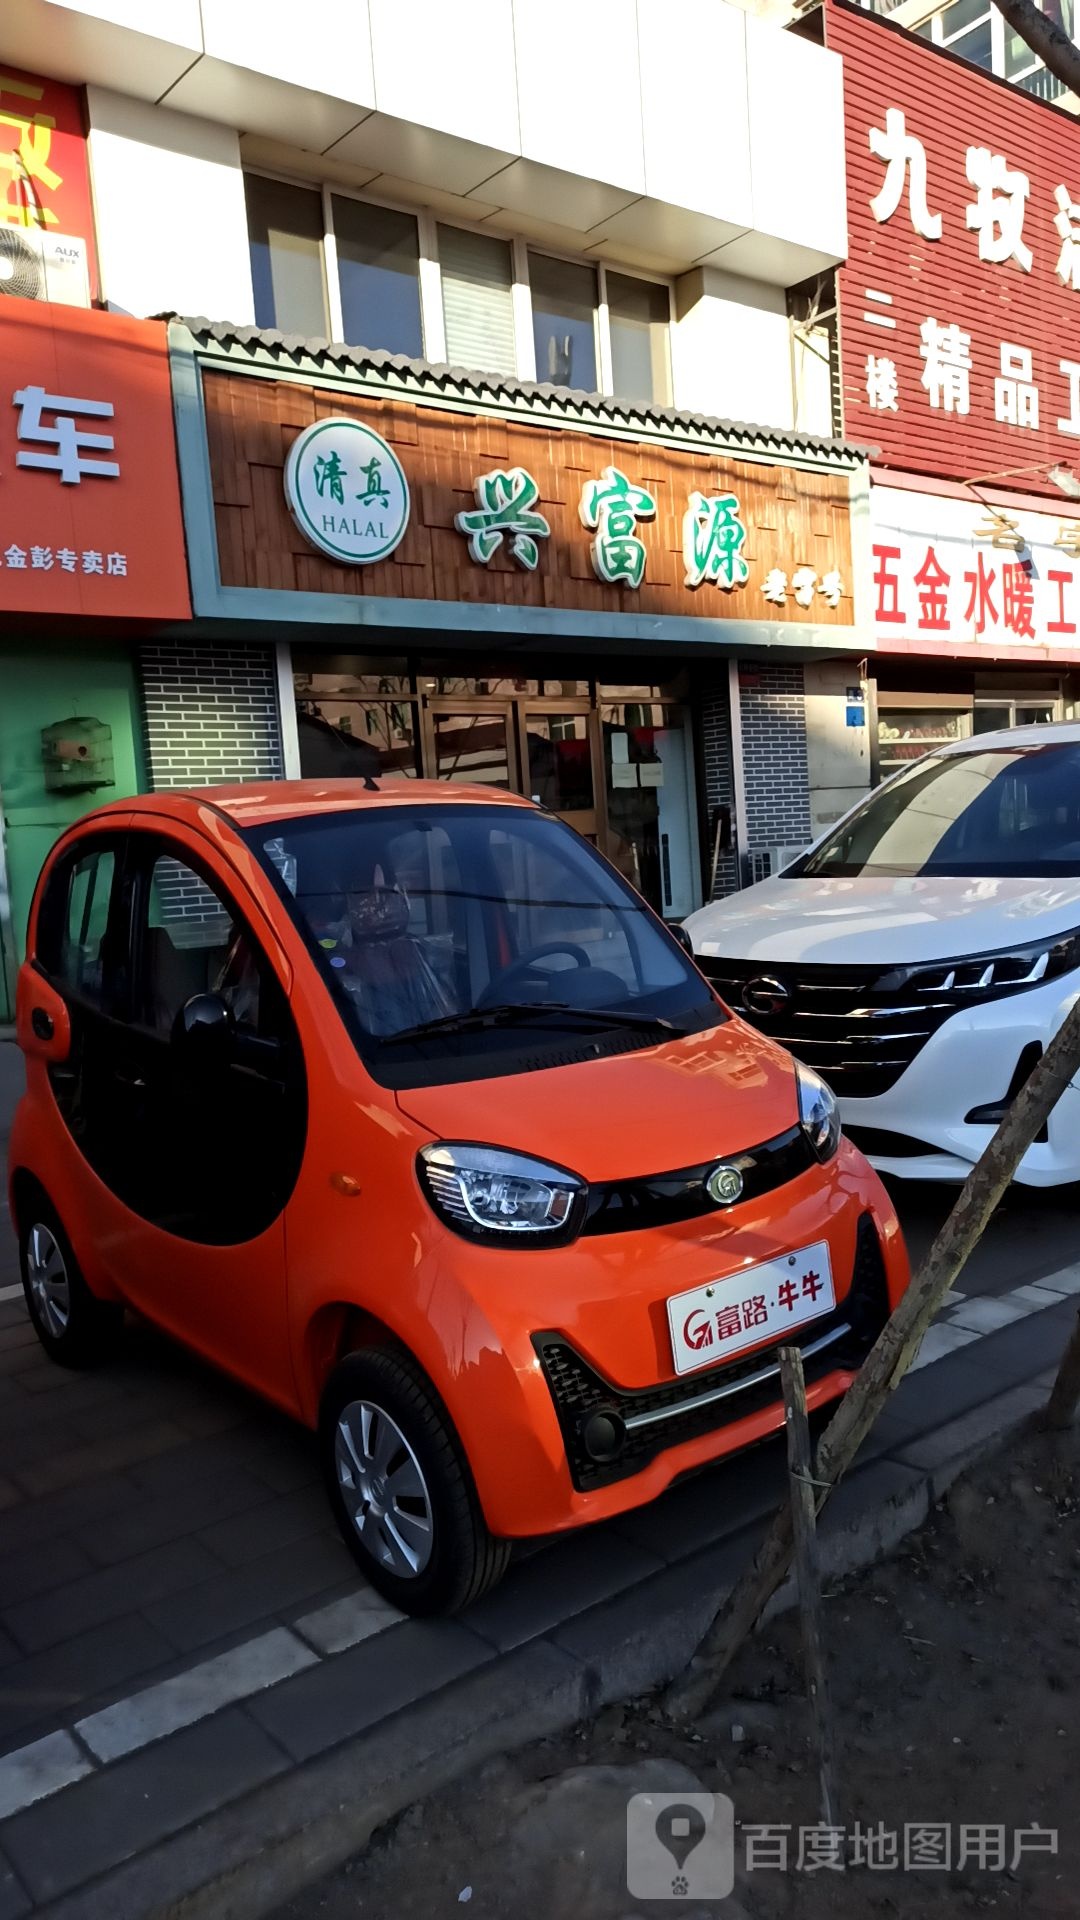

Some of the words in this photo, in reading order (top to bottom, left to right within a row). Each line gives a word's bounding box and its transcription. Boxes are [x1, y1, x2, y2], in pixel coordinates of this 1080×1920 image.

[55, 246, 80, 258] AUX
[864, 289, 899, 412] 二楼
[13, 385, 120, 485] 车
[313, 449, 391, 510] 清真
[4, 544, 128, 576] 金彭专卖店
[321, 515, 390, 540] HALAL
[455, 466, 749, 590] 兴富源
[872, 544, 1076, 640] 五金水暖工
